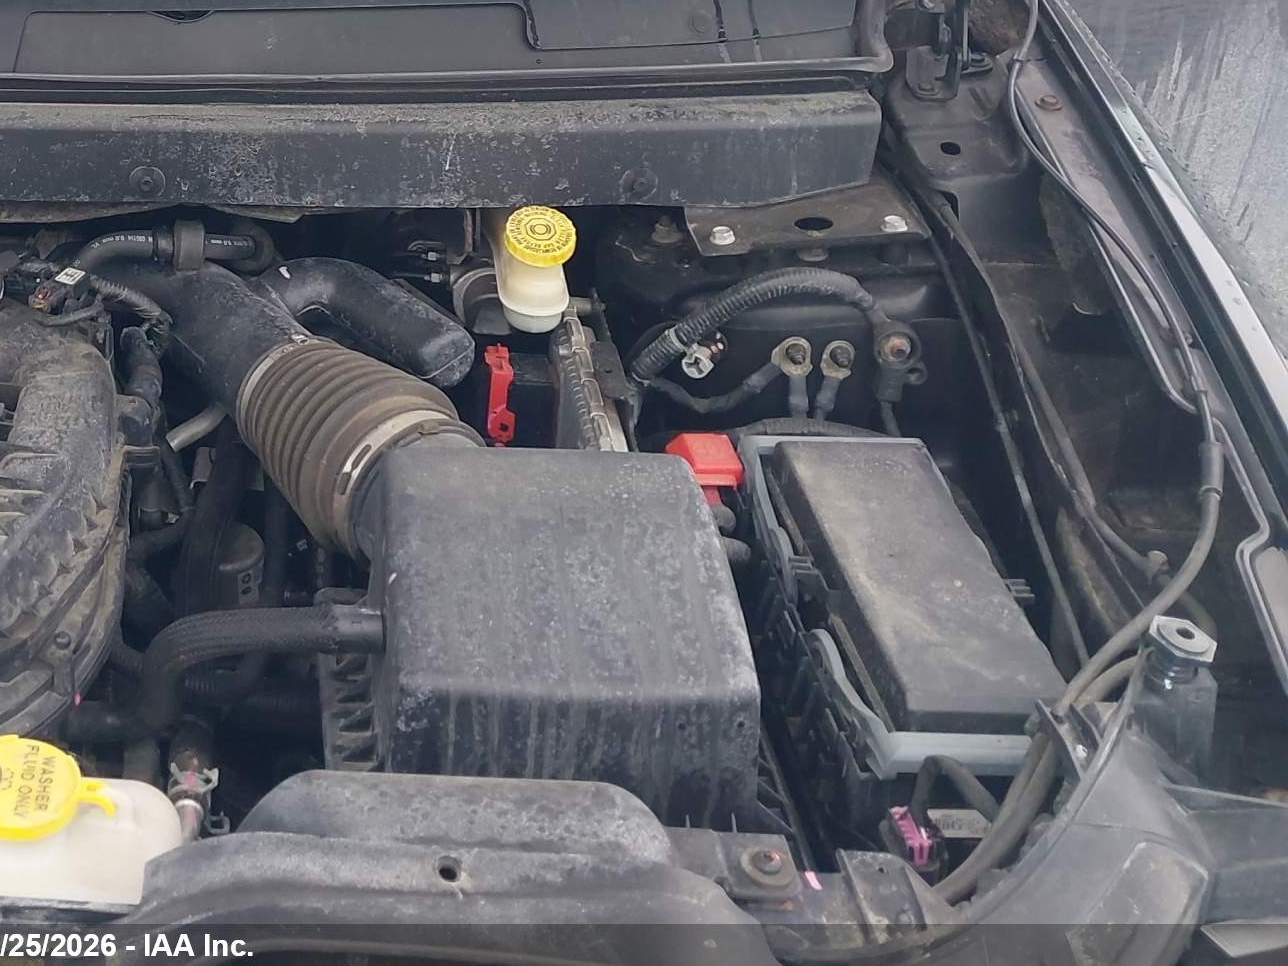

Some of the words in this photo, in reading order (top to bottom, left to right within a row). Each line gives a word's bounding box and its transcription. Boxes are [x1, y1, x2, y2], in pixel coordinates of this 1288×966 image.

[20, 744, 40, 782] FLUID
[14, 785, 32, 818] ONLY
[35, 756, 57, 811] WASHER
